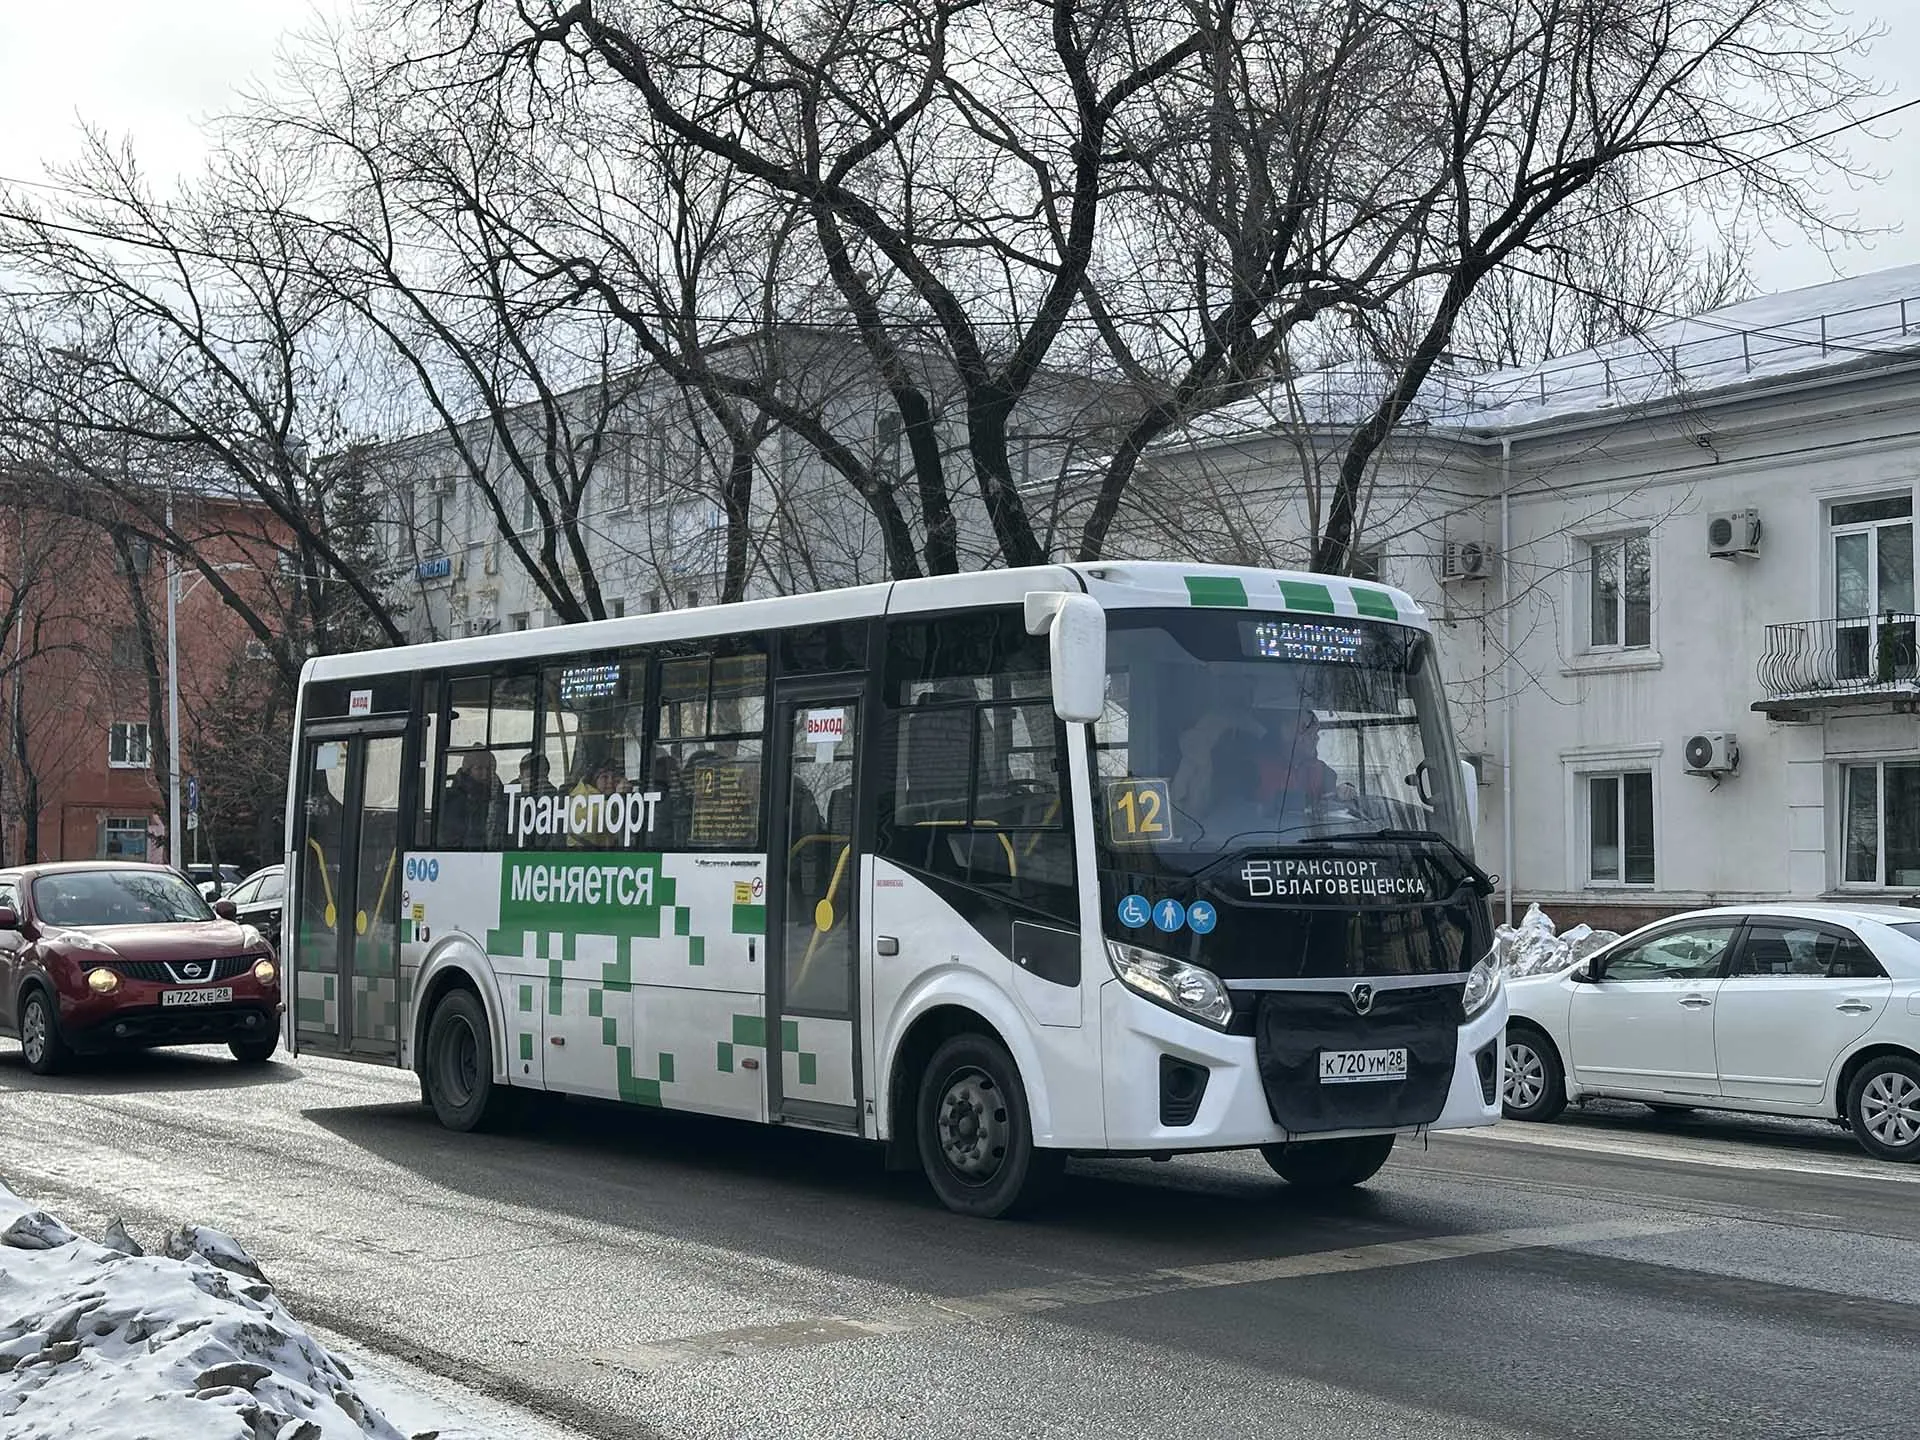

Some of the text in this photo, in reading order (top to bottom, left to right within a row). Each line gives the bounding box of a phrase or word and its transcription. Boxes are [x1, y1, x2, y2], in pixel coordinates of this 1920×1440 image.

[808, 717, 842, 733] ВЫХОД
[503, 783, 662, 848] Транспорт
[1118, 790, 1163, 833] 12
[1273, 859, 1377, 877] ТРАНСПОРТ
[511, 864, 654, 906] меняется
[1276, 878, 1425, 897] БЛАГОВЕЩЕНСКА
[217, 988, 229, 998] 28
[1389, 1050, 1402, 1066] 28
